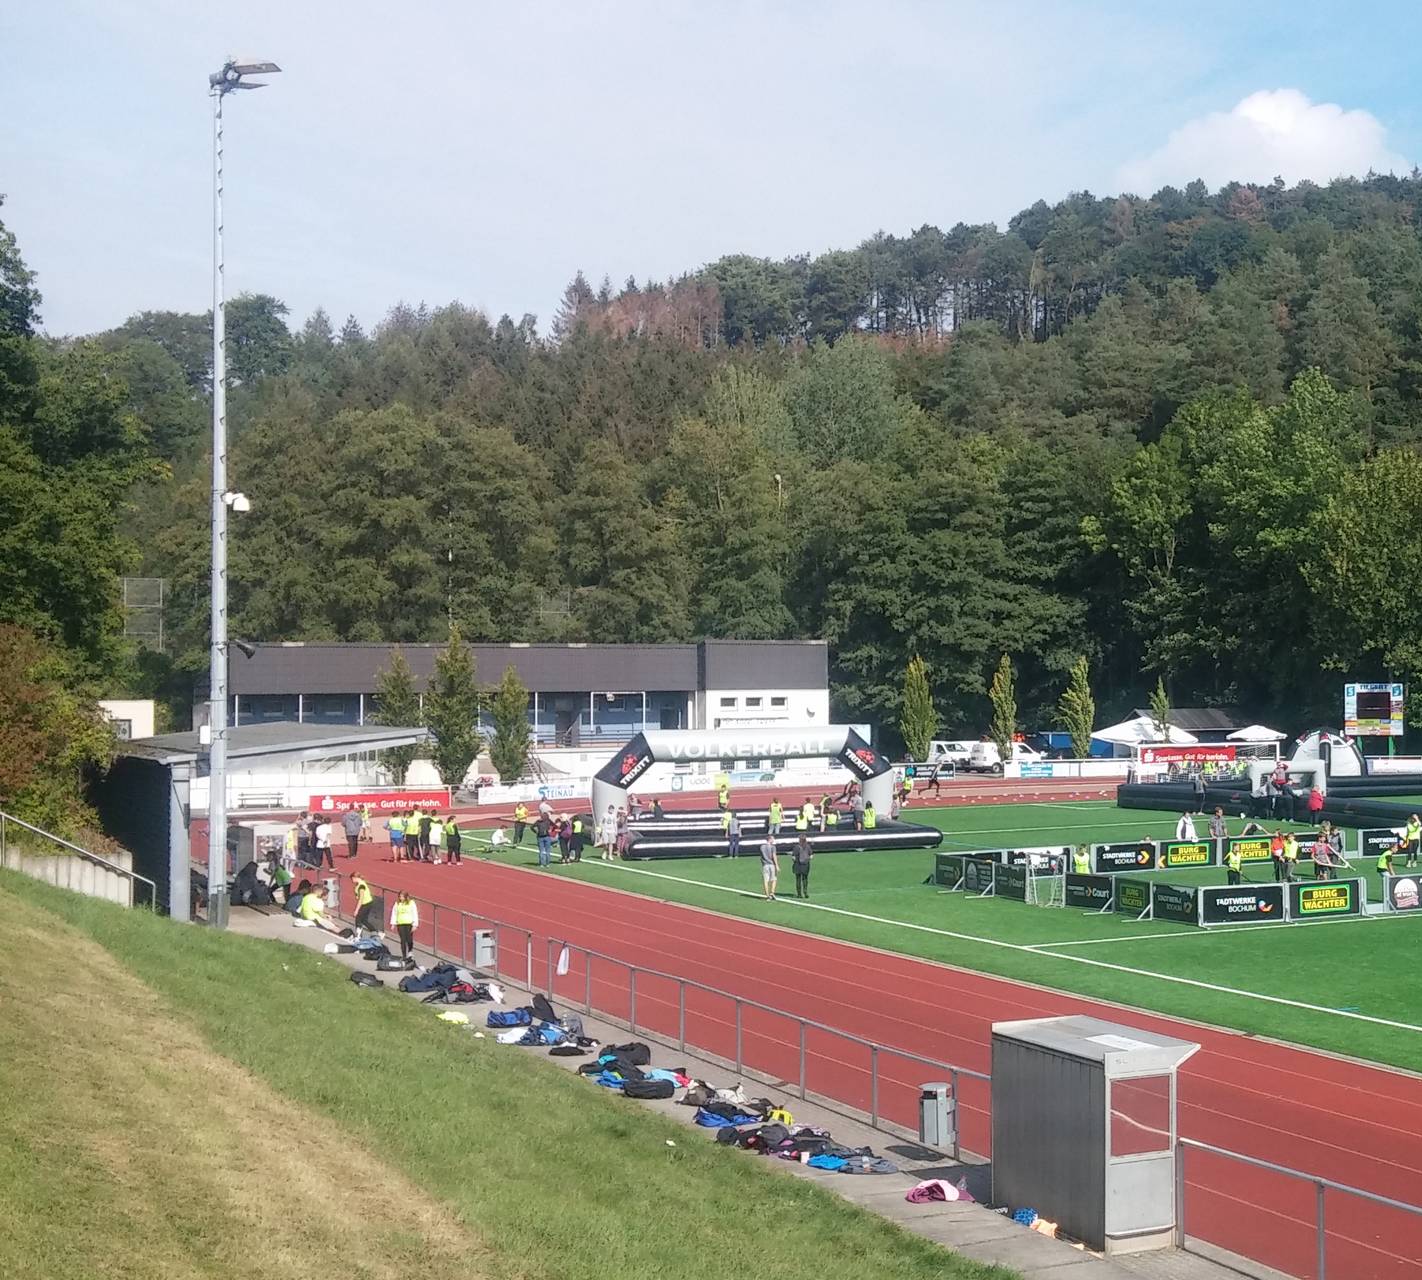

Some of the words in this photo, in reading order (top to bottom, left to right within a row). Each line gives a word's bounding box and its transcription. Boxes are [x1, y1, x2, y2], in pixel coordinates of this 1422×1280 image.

[845, 748, 874, 776] TRIXITT
[620, 756, 650, 785] TRIXITT
[538, 785, 574, 800] STEINAU
[381, 800, 394, 808] Gut
[396, 799, 407, 808] für
[1092, 887, 1110, 899] Court
[1312, 889, 1338, 898] BURG
[1216, 897, 1256, 905] TADTWERKE
